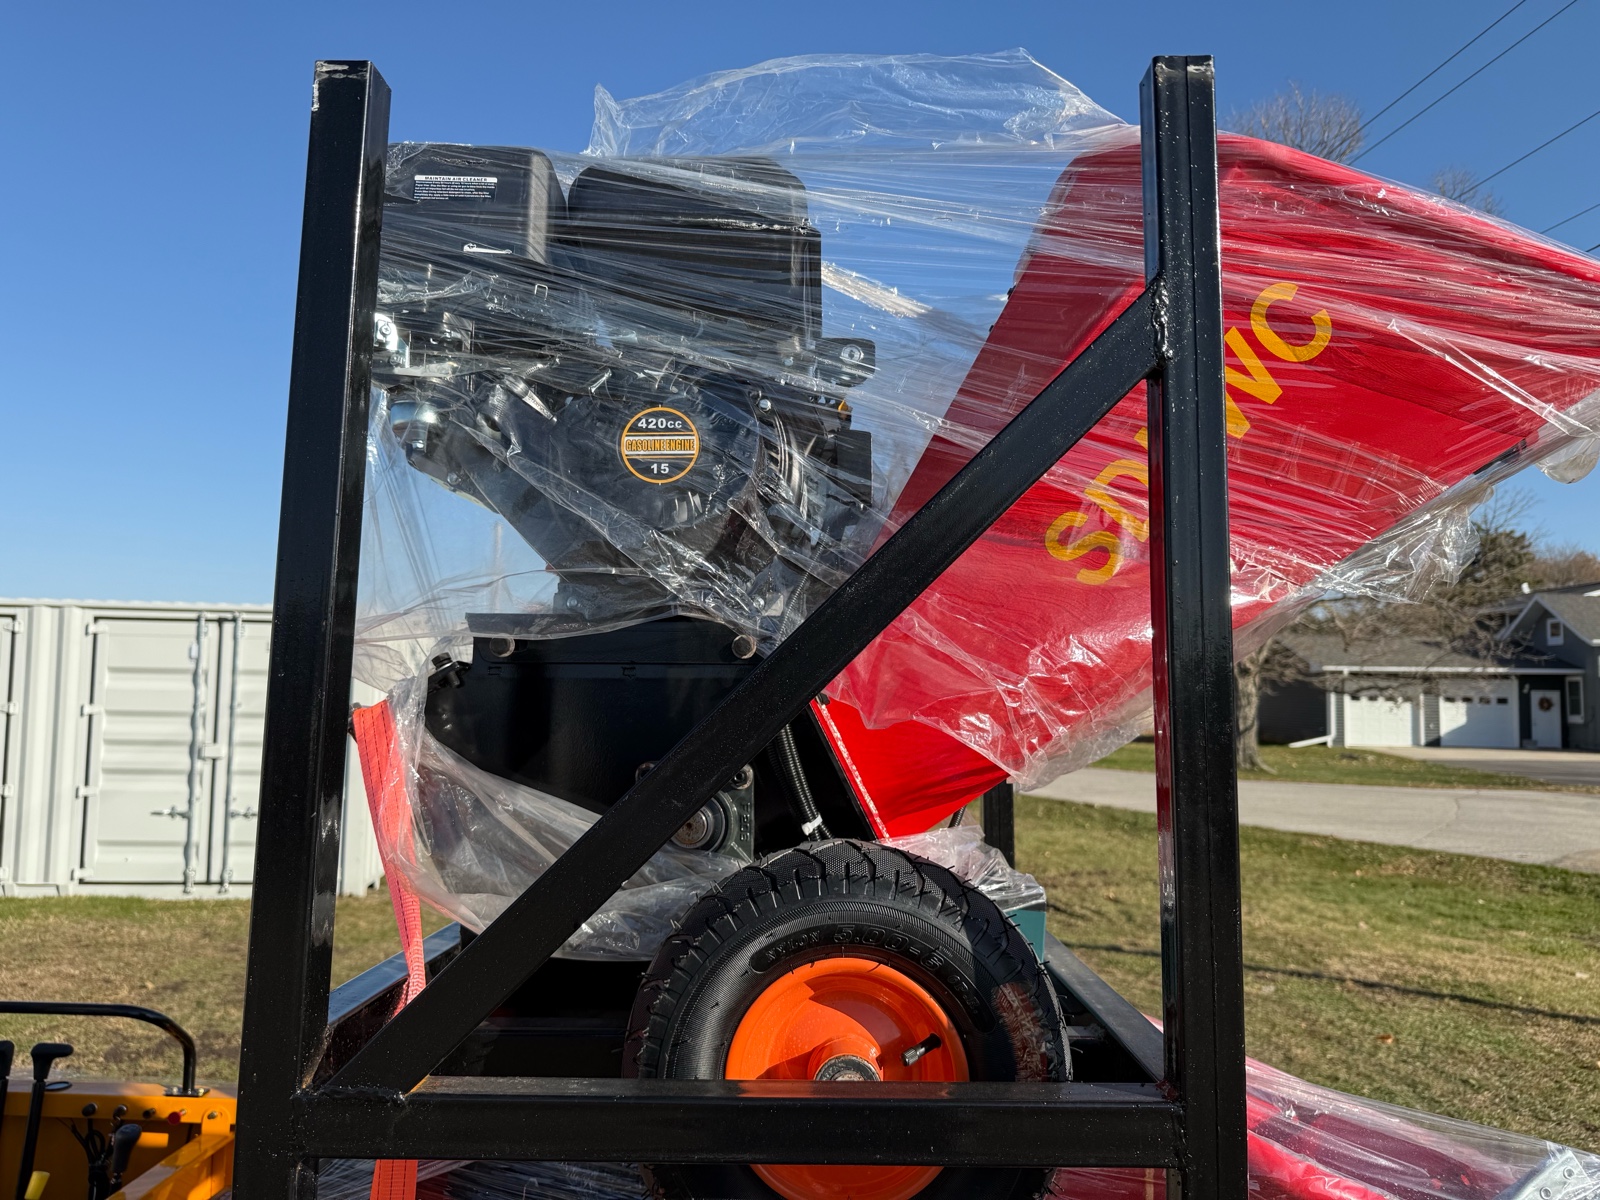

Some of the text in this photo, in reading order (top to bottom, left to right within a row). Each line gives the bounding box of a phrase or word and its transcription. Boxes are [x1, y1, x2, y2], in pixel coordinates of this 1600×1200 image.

[637, 418, 683, 429] 420cc
[1045, 282, 1332, 585] SDWC
[625, 438, 695, 452] GASOLINE ENGINE
[650, 463, 670, 474] 15
[765, 930, 821, 963] NYLON
